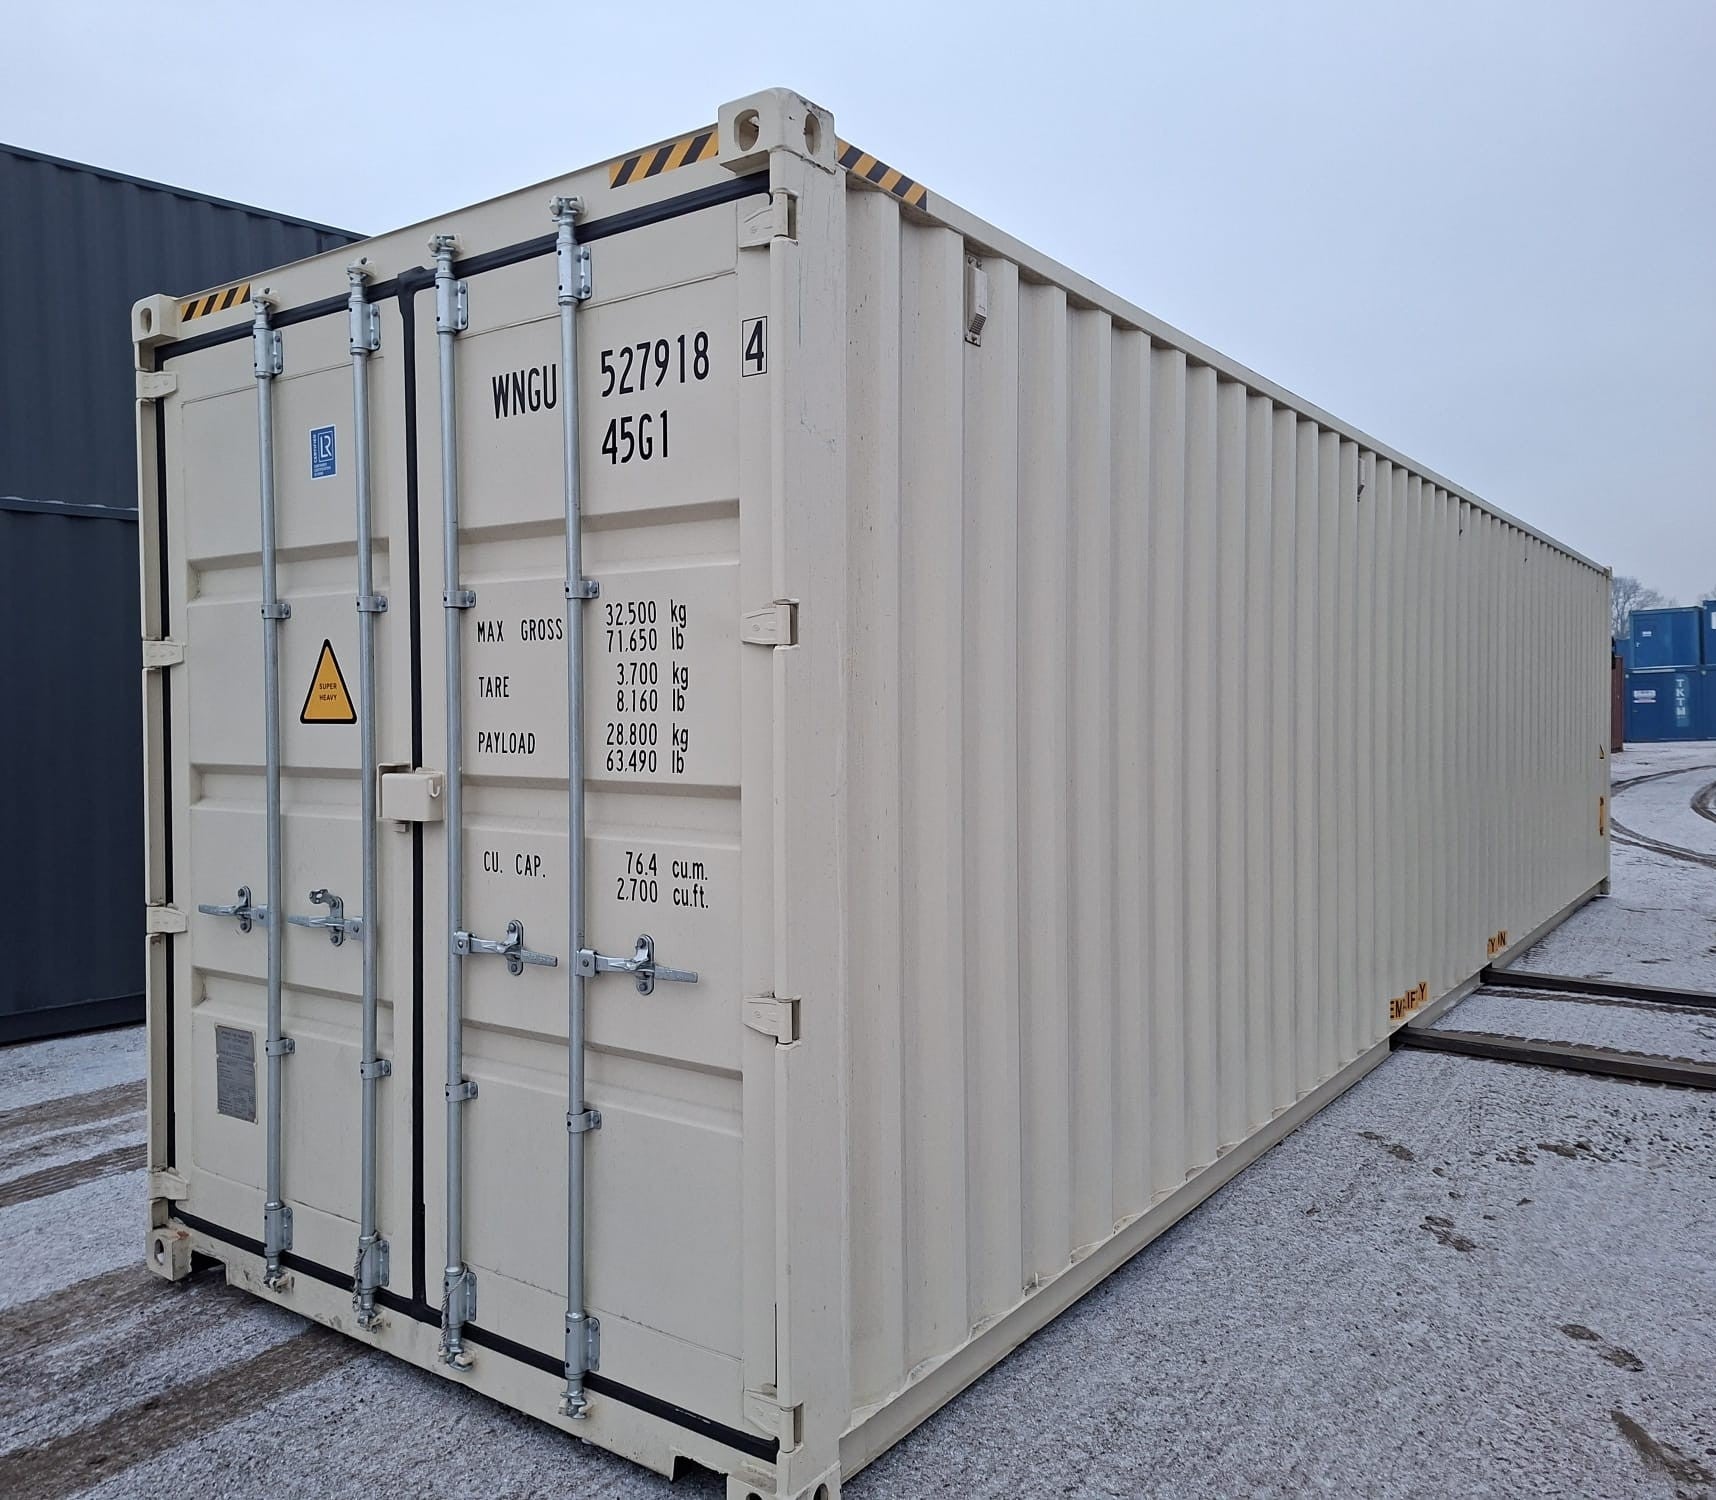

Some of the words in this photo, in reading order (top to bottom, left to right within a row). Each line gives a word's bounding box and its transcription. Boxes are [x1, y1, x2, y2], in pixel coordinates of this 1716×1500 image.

[492, 363, 557, 419] WNGU
[600, 331, 709, 397] 527918
[745, 320, 764, 371] 4
[601, 409, 668, 464] 45G1
[477, 620, 504, 642] MAX
[521, 618, 563, 641] GROSS
[670, 599, 686, 628] kg
[671, 627, 684, 650] lb
[478, 676, 510, 698] TARE
[672, 661, 689, 690] kg
[672, 688, 685, 712] lb
[478, 731, 536, 755] PAYLOAD
[672, 723, 689, 752] kg
[671, 750, 684, 774] lb
[483, 850, 503, 874] CU.
[515, 854, 546, 878] CAP.
[626, 851, 657, 876] 76.4
[672, 860, 708, 880] cu.m.
[673, 883, 709, 909] cu.ft.
